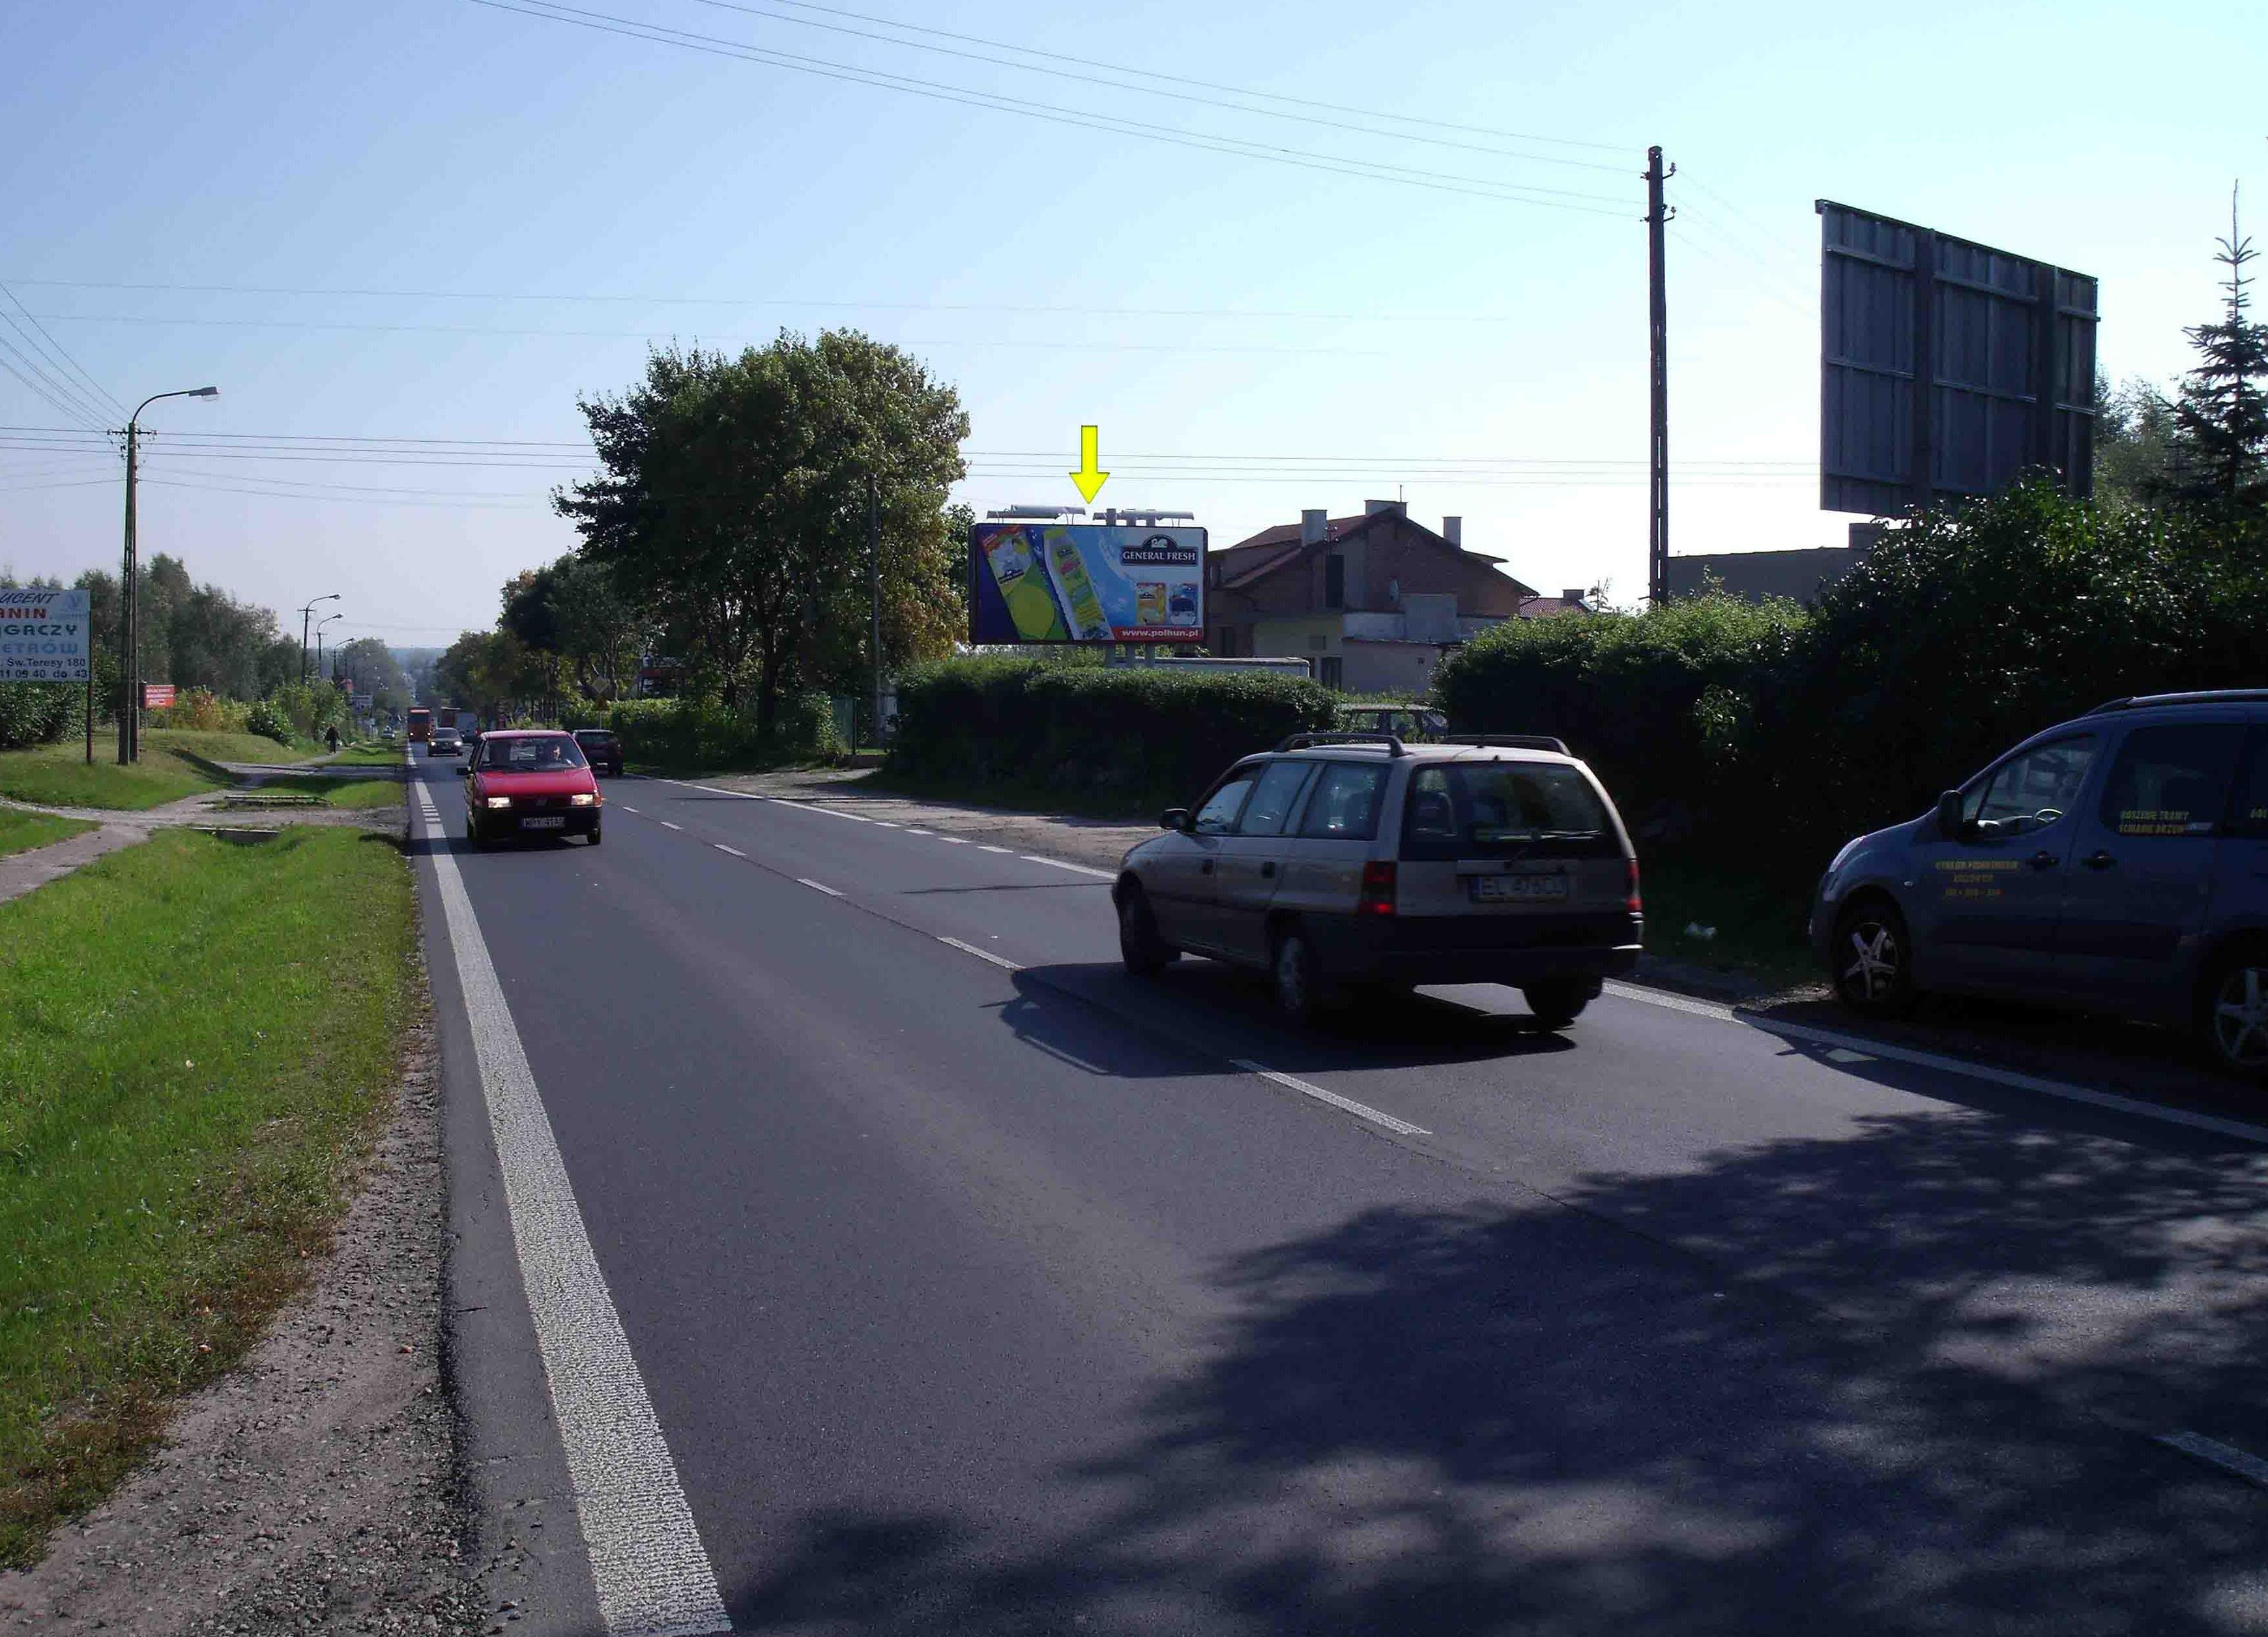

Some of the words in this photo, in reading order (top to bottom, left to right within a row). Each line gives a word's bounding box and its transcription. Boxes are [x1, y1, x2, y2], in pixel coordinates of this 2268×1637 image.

[1122, 551, 1165, 560] GENERAL
[1167, 552, 1196, 561] FRESH
[0, 624, 77, 636] GACZY
[1122, 629, 1199, 637] www.polhun.pl
[67, 658, 86, 667] 180
